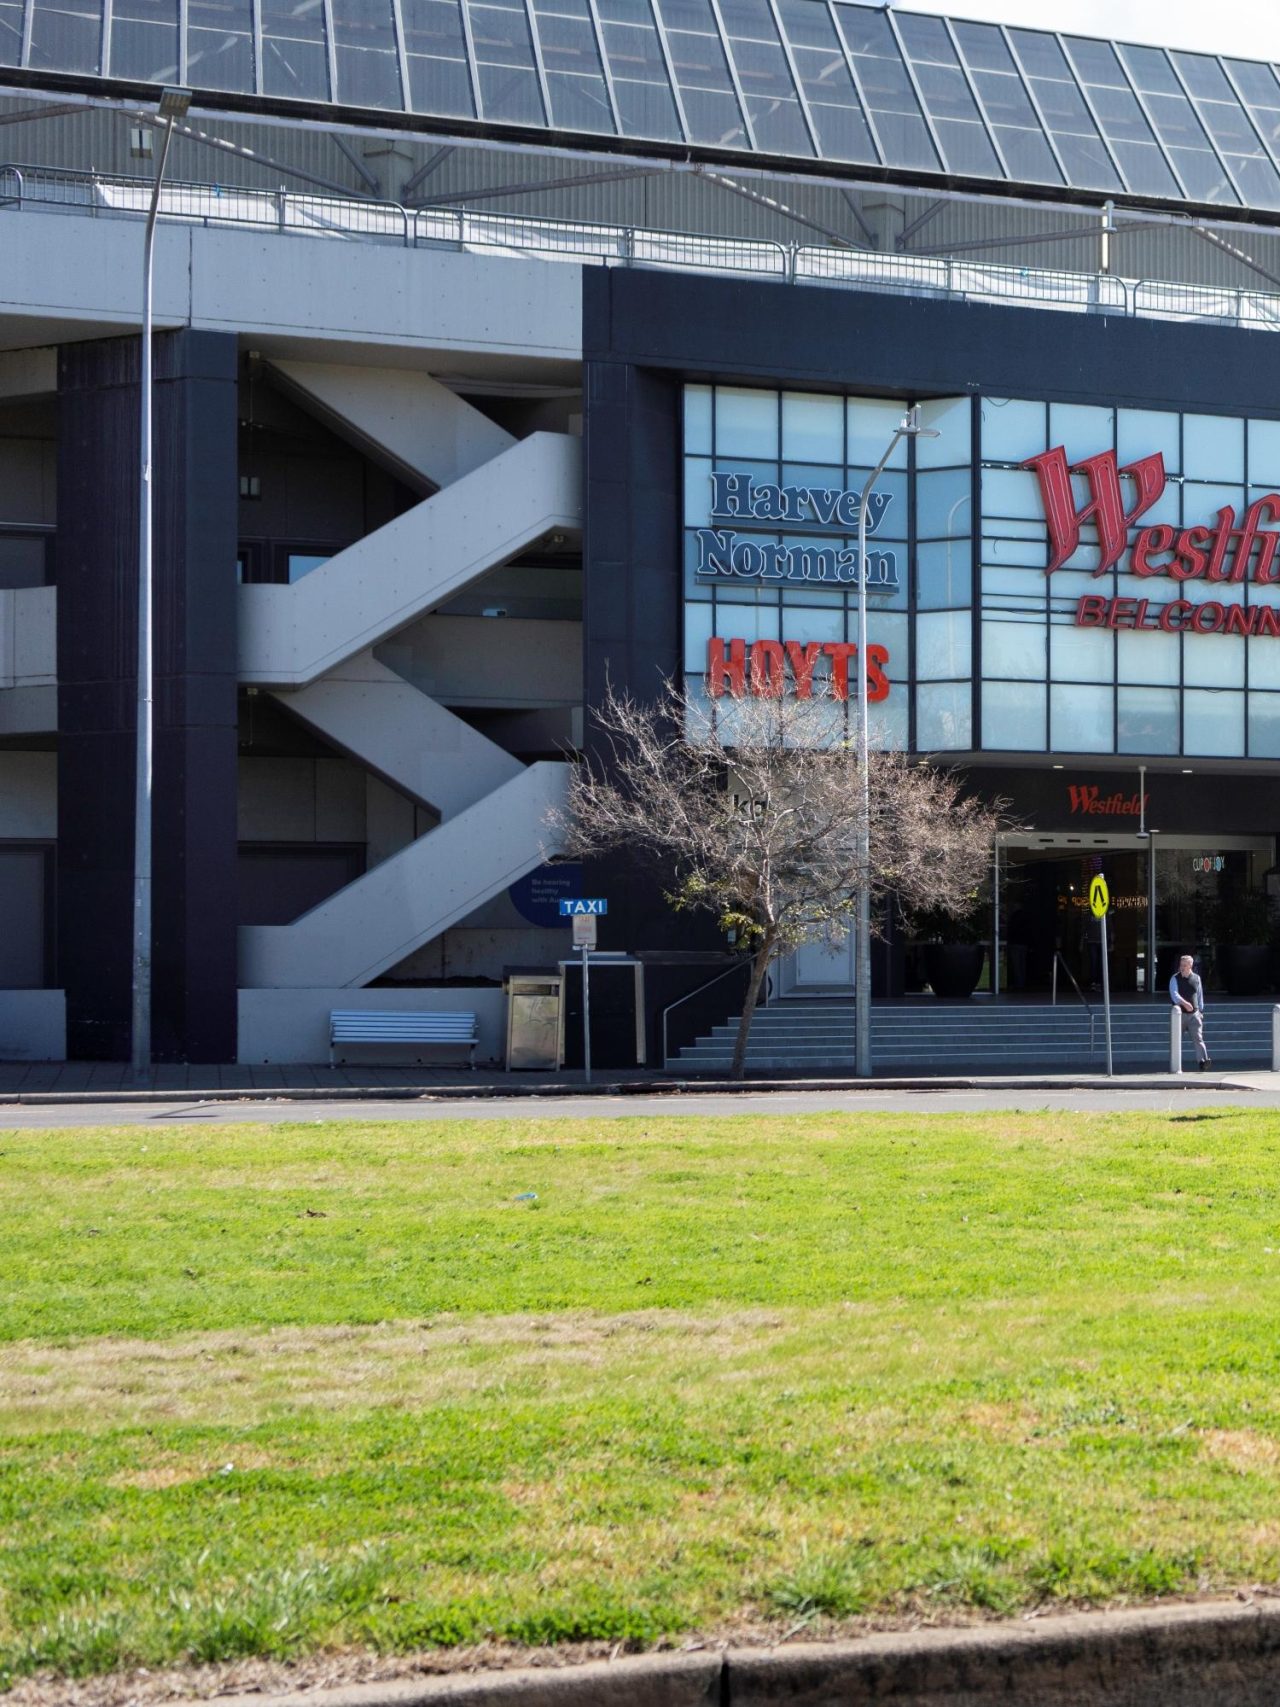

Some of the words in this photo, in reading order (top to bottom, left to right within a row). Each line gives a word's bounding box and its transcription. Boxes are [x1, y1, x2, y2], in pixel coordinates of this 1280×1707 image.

[711, 472, 893, 535] Harvey
[697, 530, 899, 585] Norman
[707, 637, 890, 704] HOYTS
[1067, 785, 1150, 816] Westfield
[564, 900, 603, 914] TAXI
